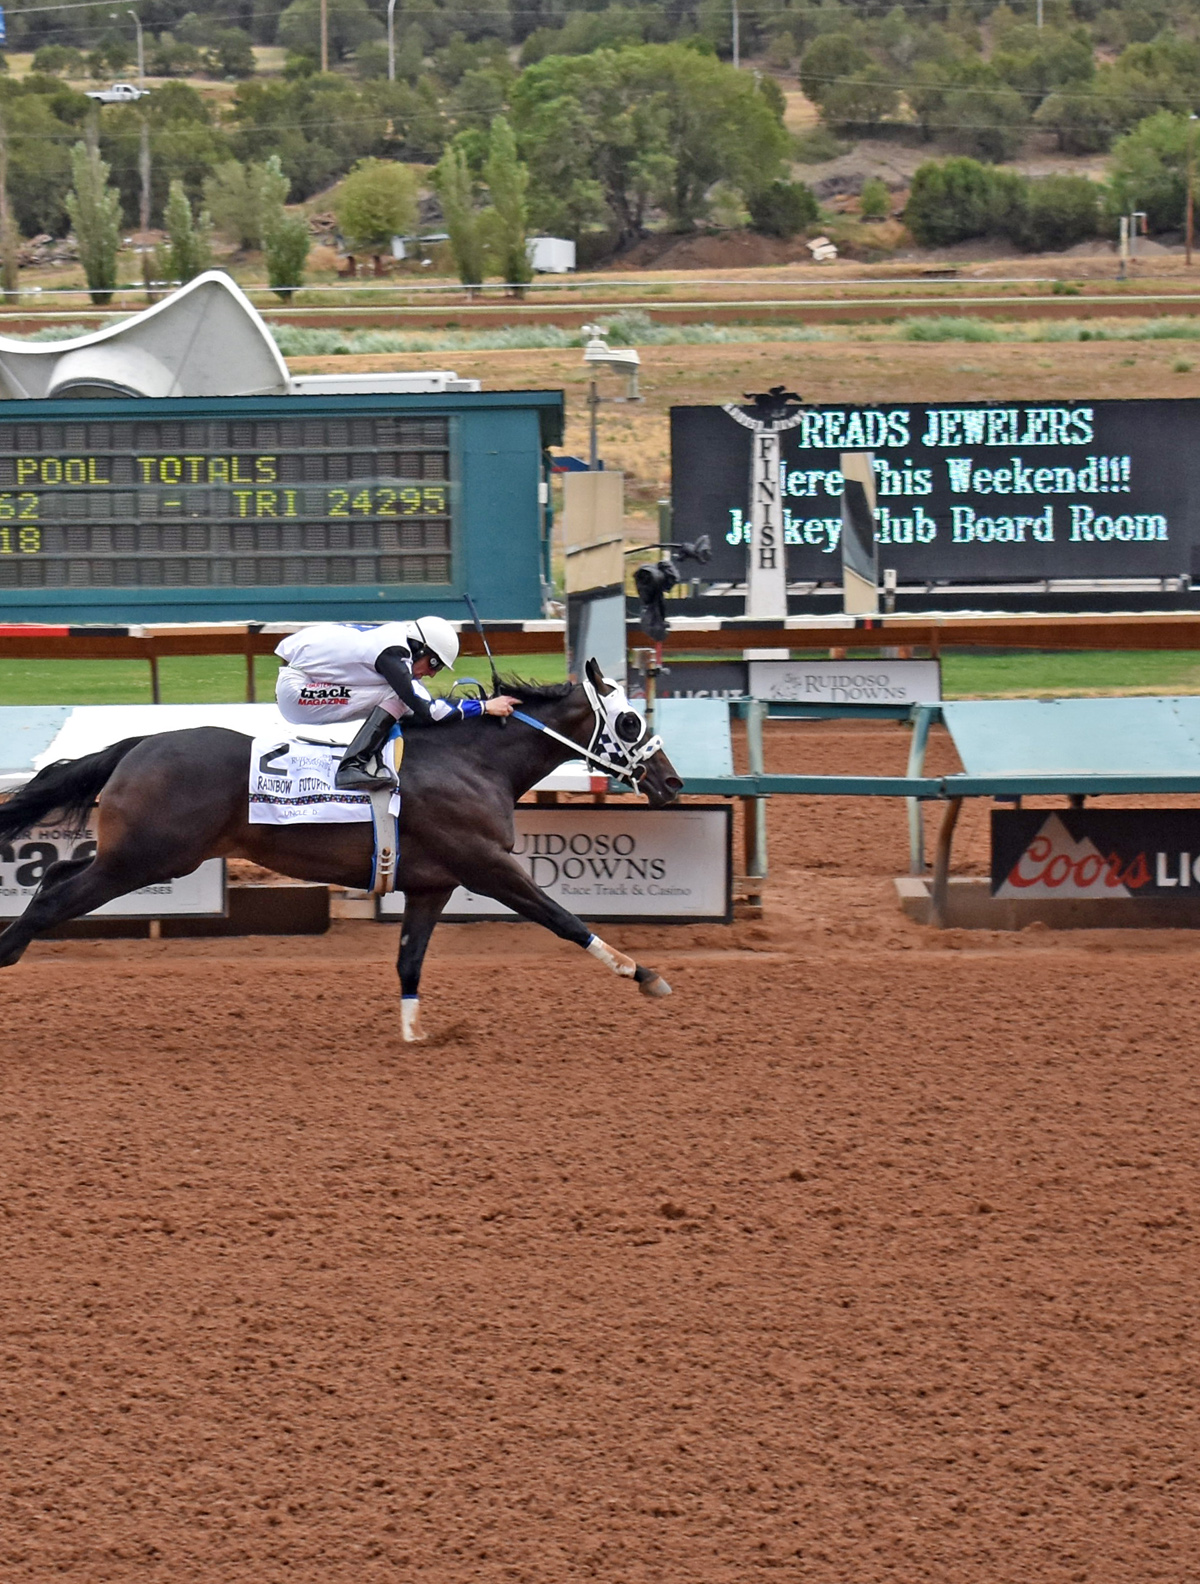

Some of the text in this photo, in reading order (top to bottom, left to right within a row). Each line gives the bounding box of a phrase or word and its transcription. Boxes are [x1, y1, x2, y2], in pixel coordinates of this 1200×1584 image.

[799, 411, 910, 448] READS
[922, 408, 1094, 446] JEWELERS
[17, 458, 110, 485] POOL
[946, 456, 1131, 494] Weekend!!!
[233, 490, 297, 518] TRI
[328, 487, 445, 516] 24295
[758, 437, 777, 569] FINISH
[725, 508, 843, 553] Jkey
[950, 505, 1054, 543] Board
[1068, 504, 1169, 542] Room
[300, 686, 351, 699] track
[805, 674, 890, 694] RUIDOSO
[831, 686, 906, 701] DOWNS
[257, 776, 331, 794] RAINBOW FUTURITY
[39, 829, 93, 840] HORSE
[511, 834, 636, 857] UIDOSO
[528, 856, 666, 889] DOWNS
[1008, 836, 1200, 889] Coors LI
[134, 885, 173, 895] ORSES
[561, 883, 691, 896] Race Track & Casino
